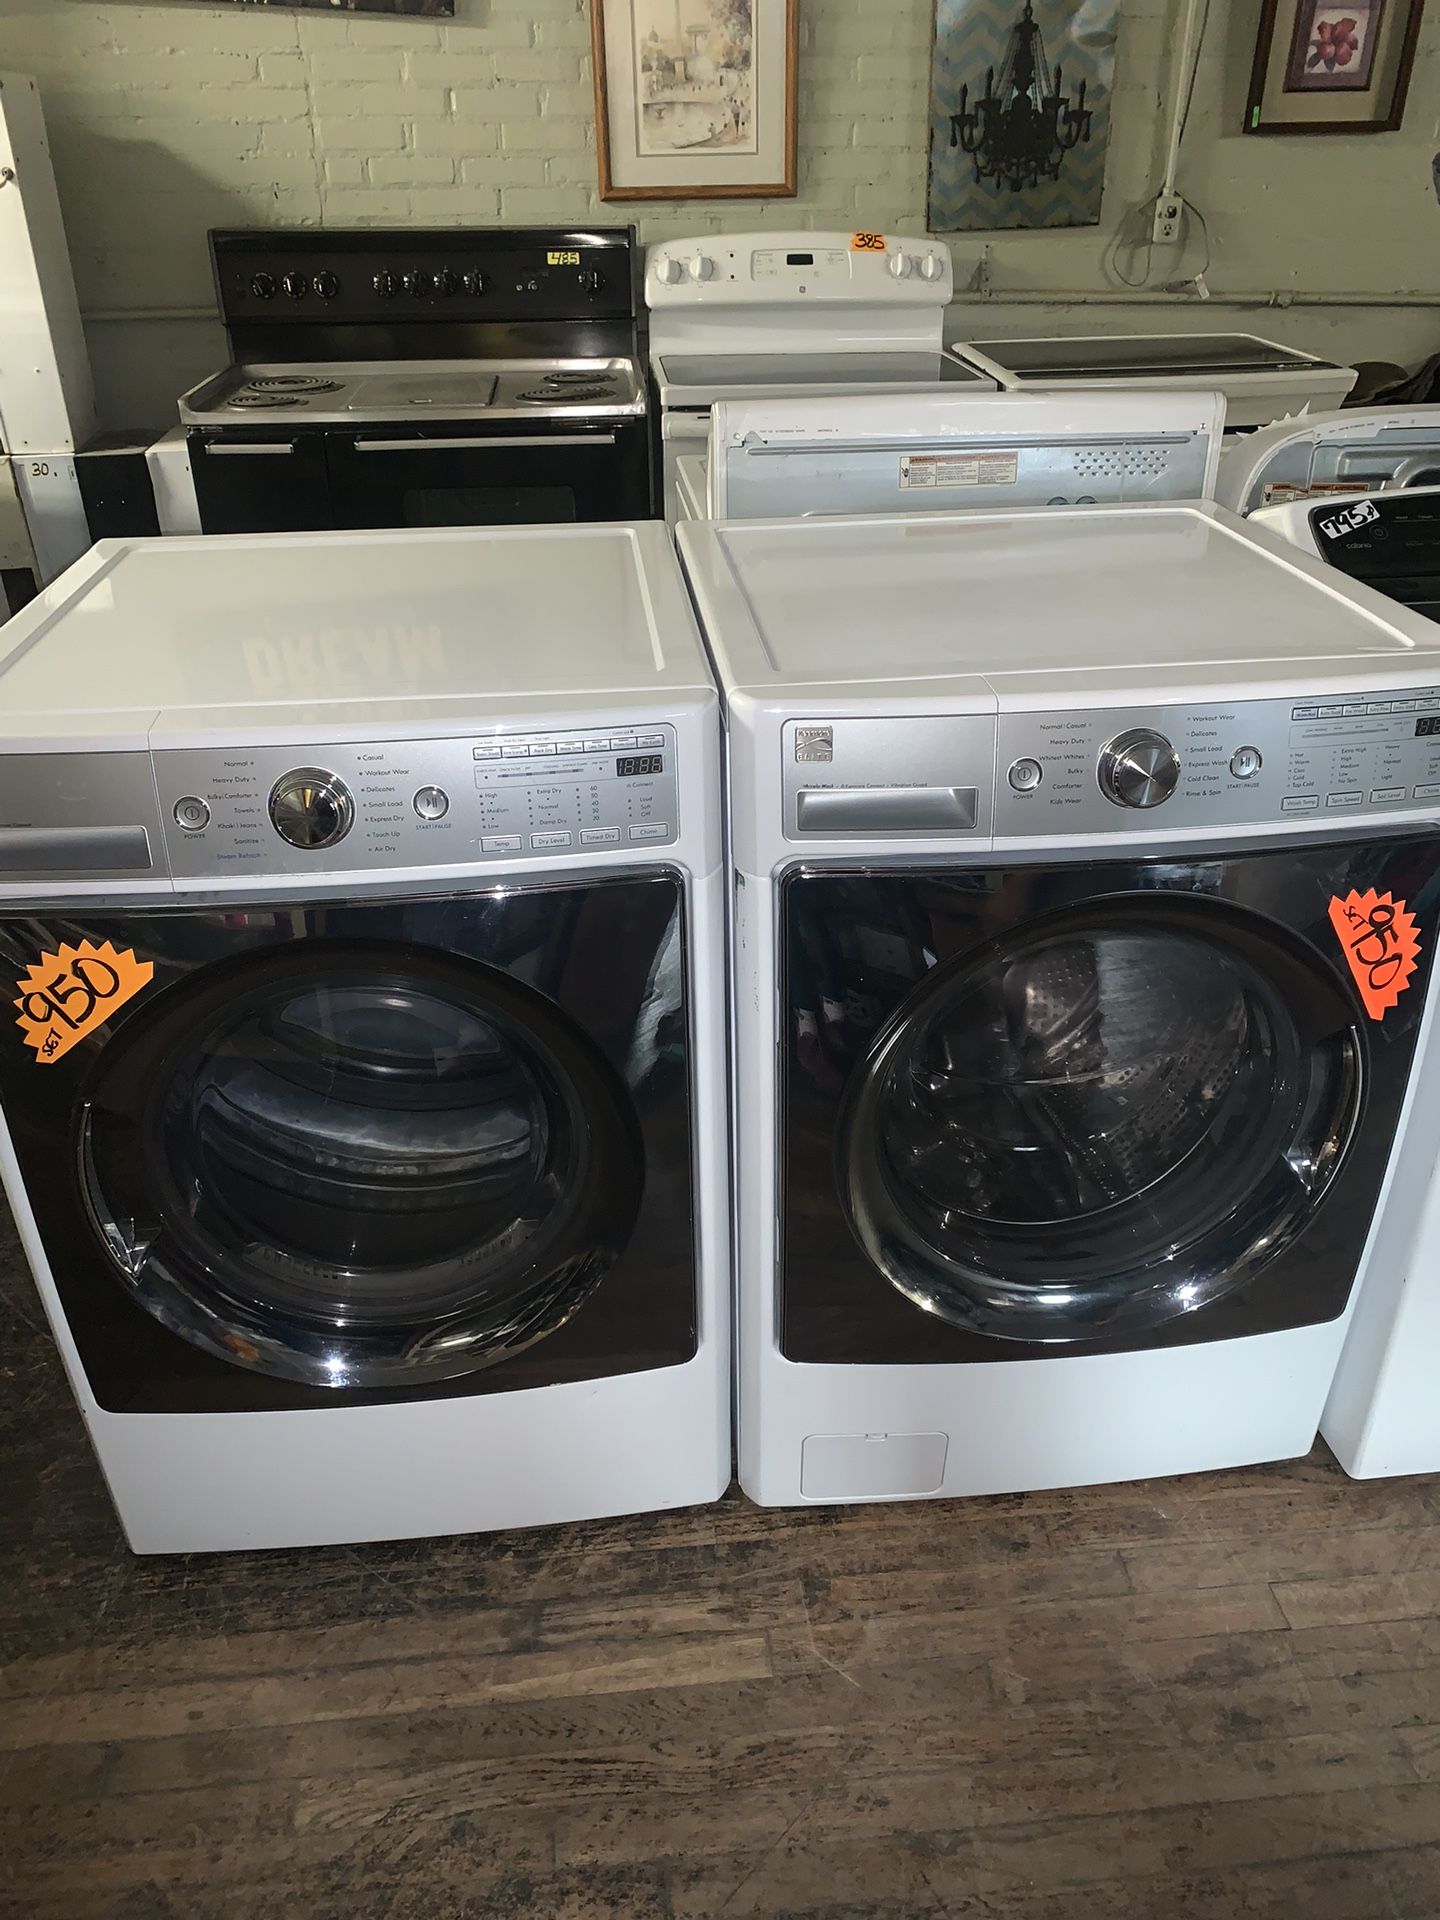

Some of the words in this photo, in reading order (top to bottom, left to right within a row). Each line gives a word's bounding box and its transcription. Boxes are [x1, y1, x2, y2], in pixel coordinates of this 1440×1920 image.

[855, 233, 885, 249] 385
[552, 252, 578, 264] 485
[32, 462, 49, 477] 30
[1351, 904, 1403, 990] 950
[22, 957, 120, 1030] 950
